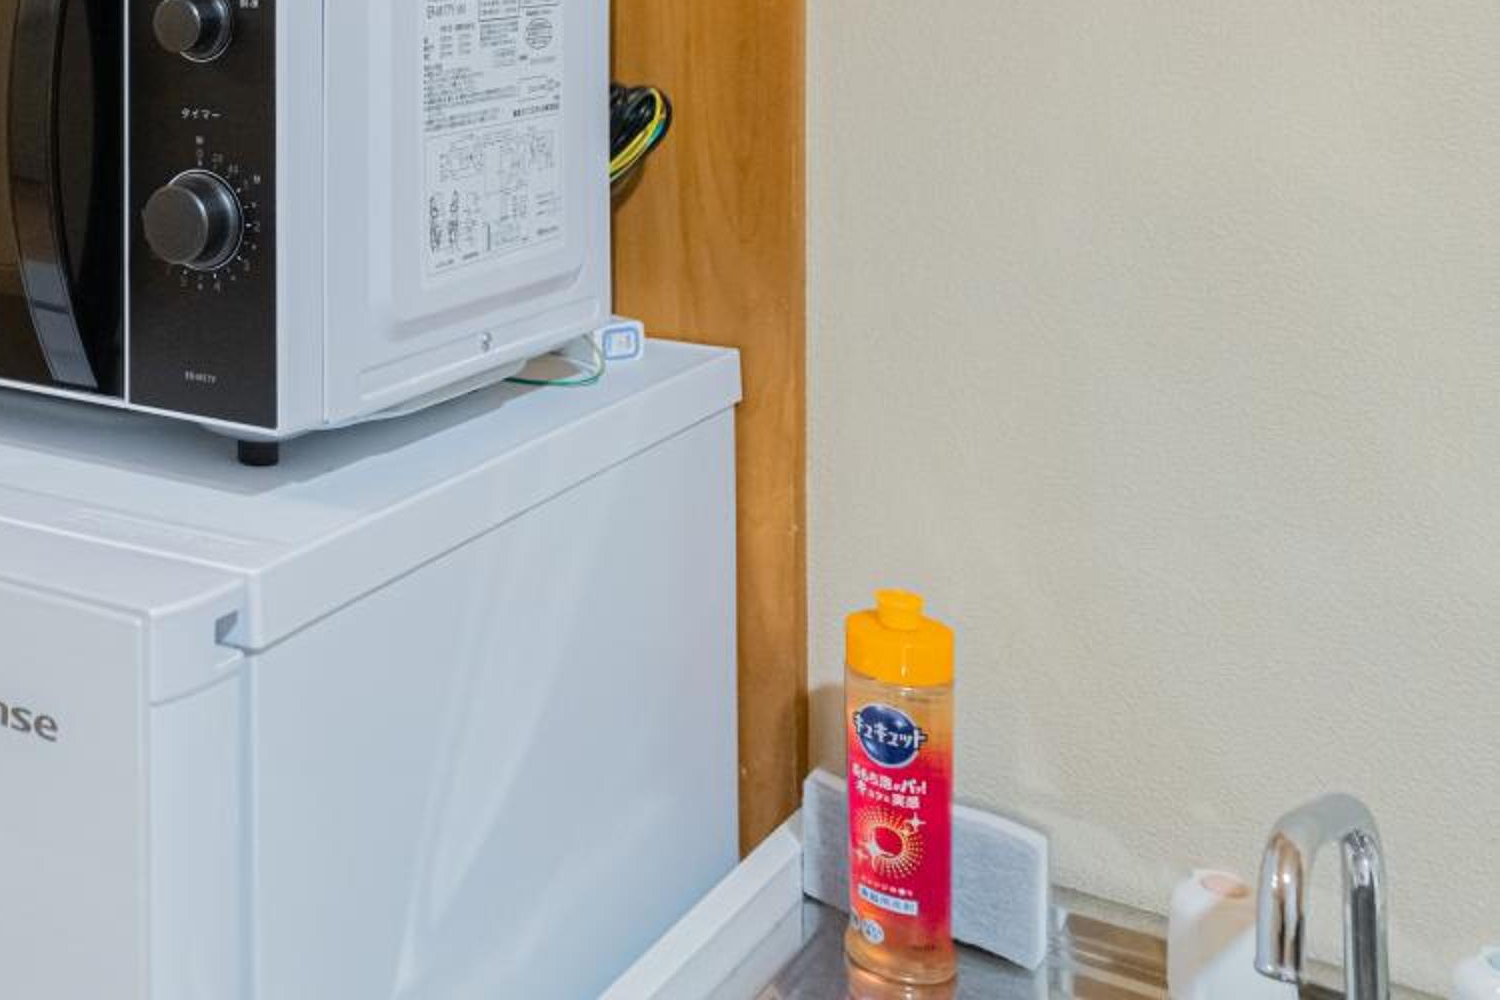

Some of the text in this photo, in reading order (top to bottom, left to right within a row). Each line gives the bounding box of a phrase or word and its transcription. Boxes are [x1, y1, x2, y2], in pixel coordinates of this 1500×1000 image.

[181, 107, 221, 119] タイマー
[855, 713, 927, 749] キュキュット
